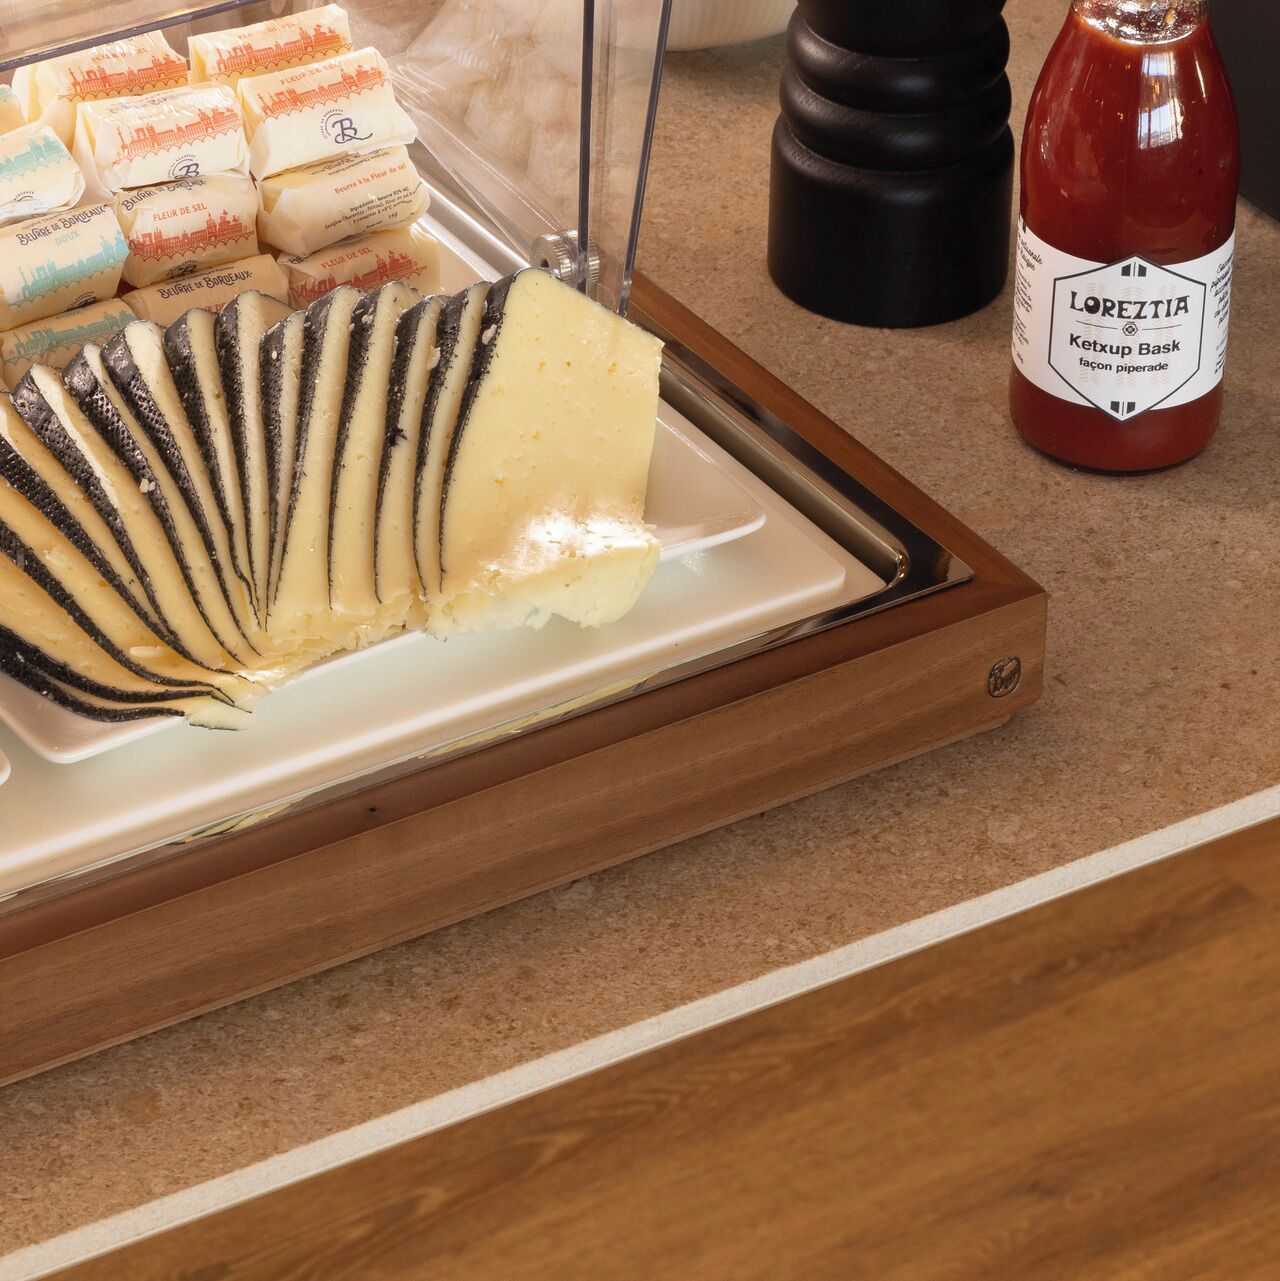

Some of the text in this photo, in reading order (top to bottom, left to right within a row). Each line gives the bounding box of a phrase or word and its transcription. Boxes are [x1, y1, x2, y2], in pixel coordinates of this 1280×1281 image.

[153, 201, 208, 221] FLEUR DE SEL
[16, 226, 54, 246] BEURRE
[52, 220, 62, 233] DE
[321, 246, 373, 270] FLEUR DE SEL
[157, 283, 195, 299] BEURRE
[195, 281, 205, 289] DE
[1070, 290, 1190, 320] LOREZTIA
[1070, 333, 1180, 358] Ketxup Bask
[1079, 357, 1169, 375] façon piperade
